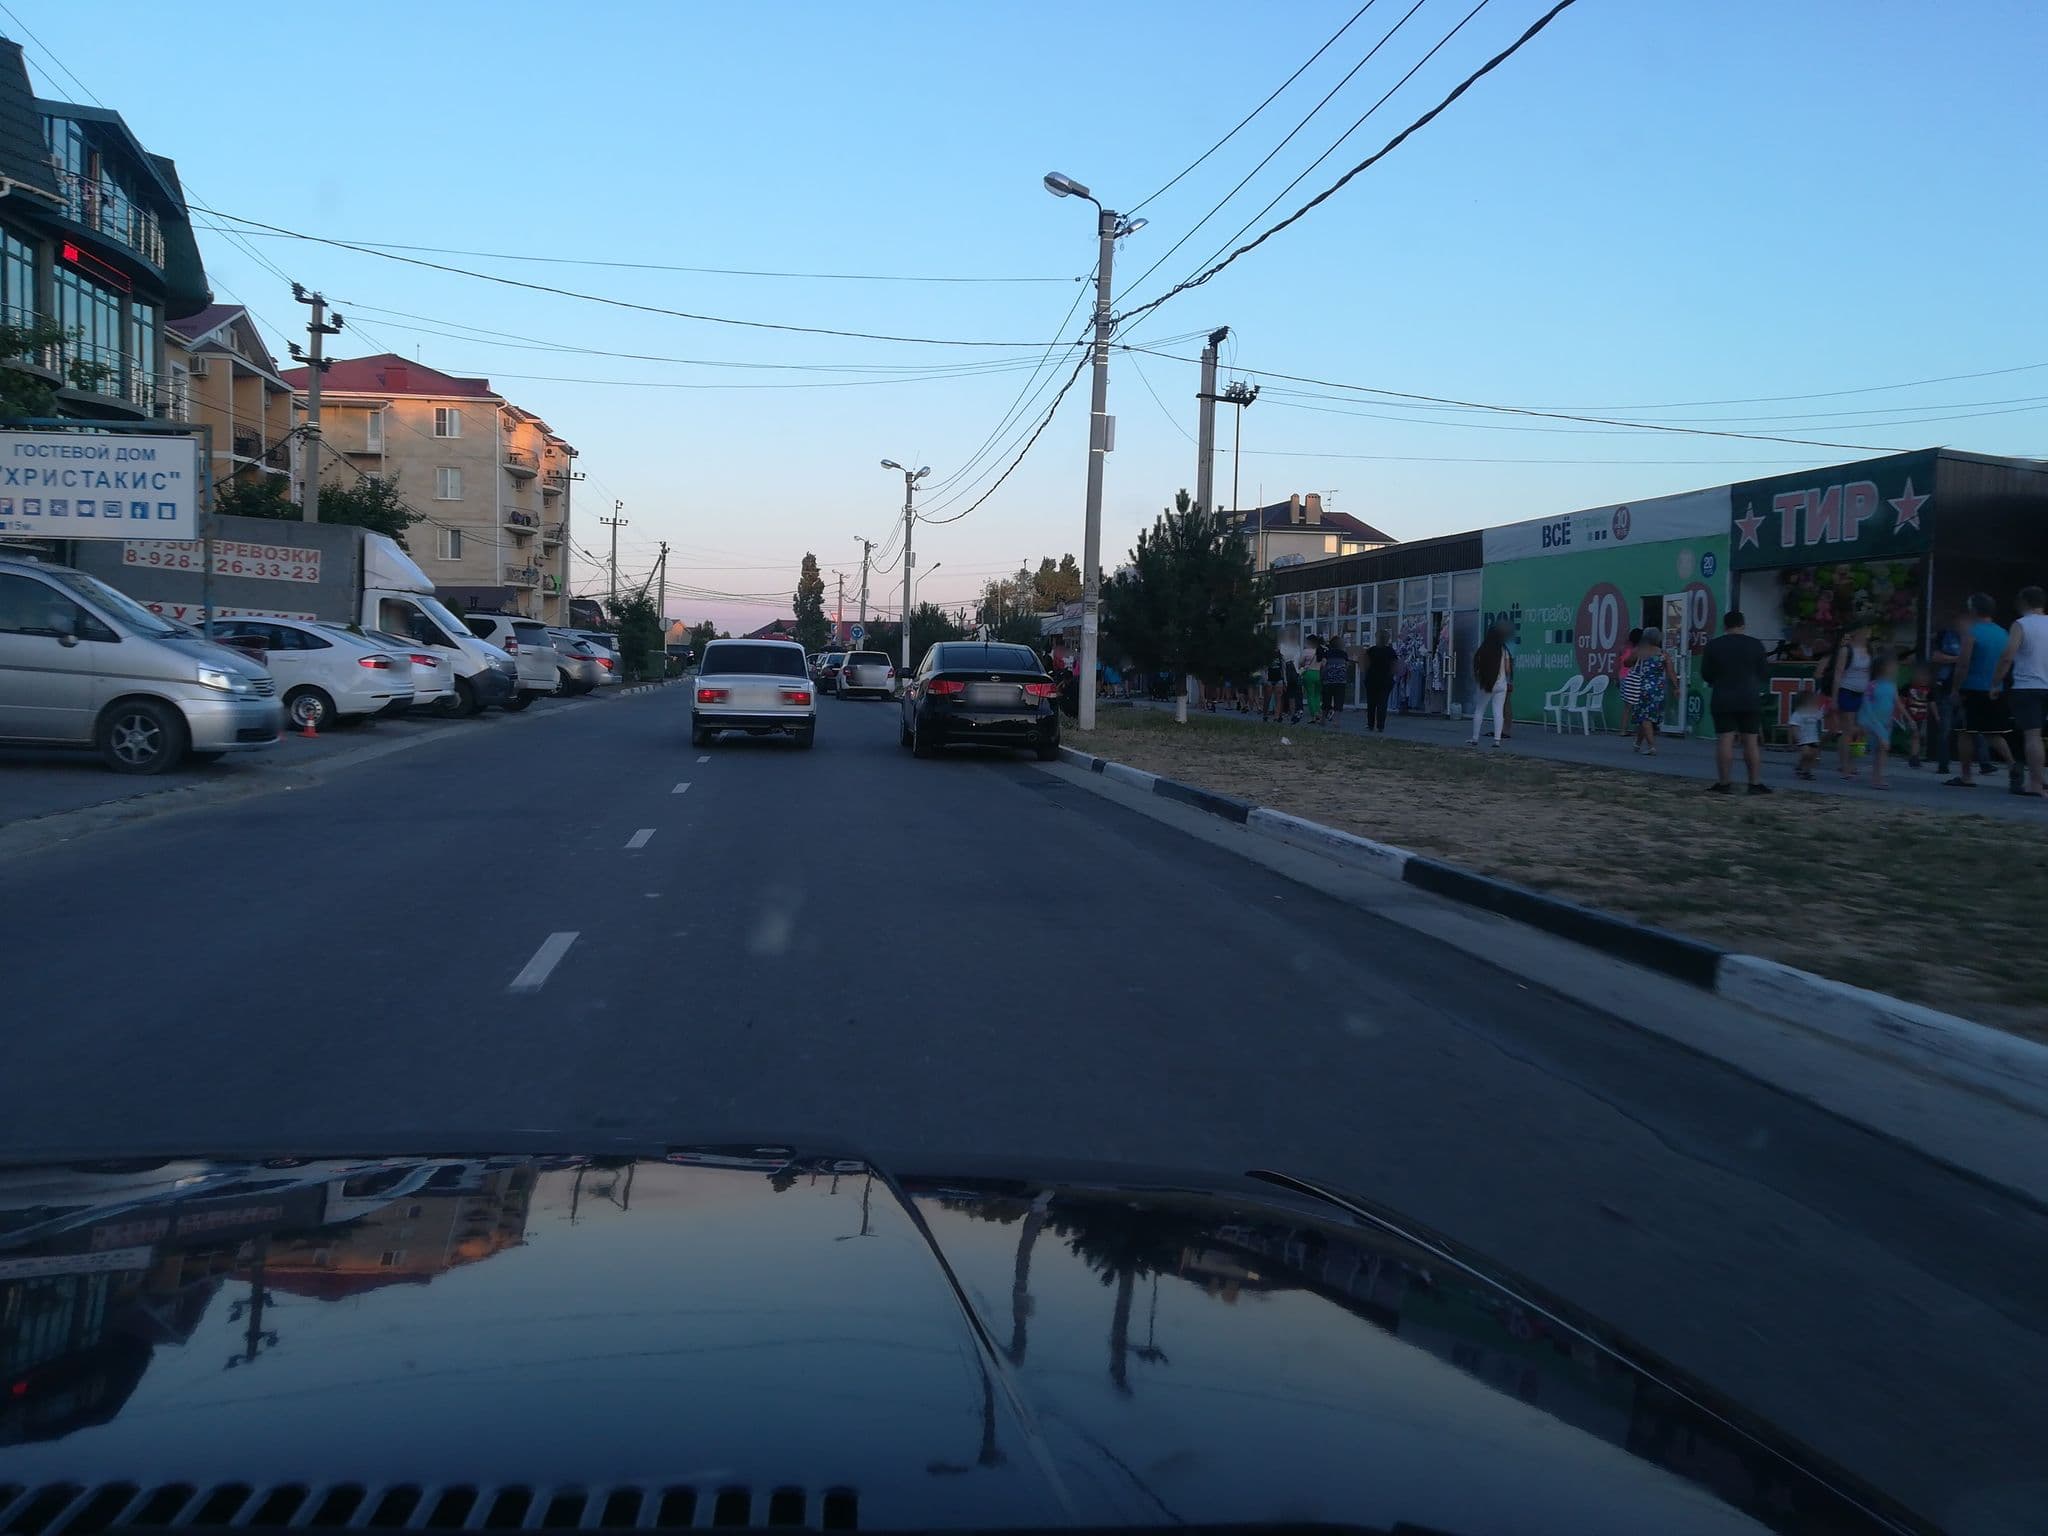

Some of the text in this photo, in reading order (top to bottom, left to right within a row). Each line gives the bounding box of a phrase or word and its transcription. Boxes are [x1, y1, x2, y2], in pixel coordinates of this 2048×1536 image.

[14, 444, 156, 462] ГОСТЕВОЙ ДОМ
[1773, 480, 1879, 548] ТИР
[1542, 516, 1571, 548] ВСЁ
[1703, 556, 1714, 569] 20
[1588, 594, 1618, 650] 10
